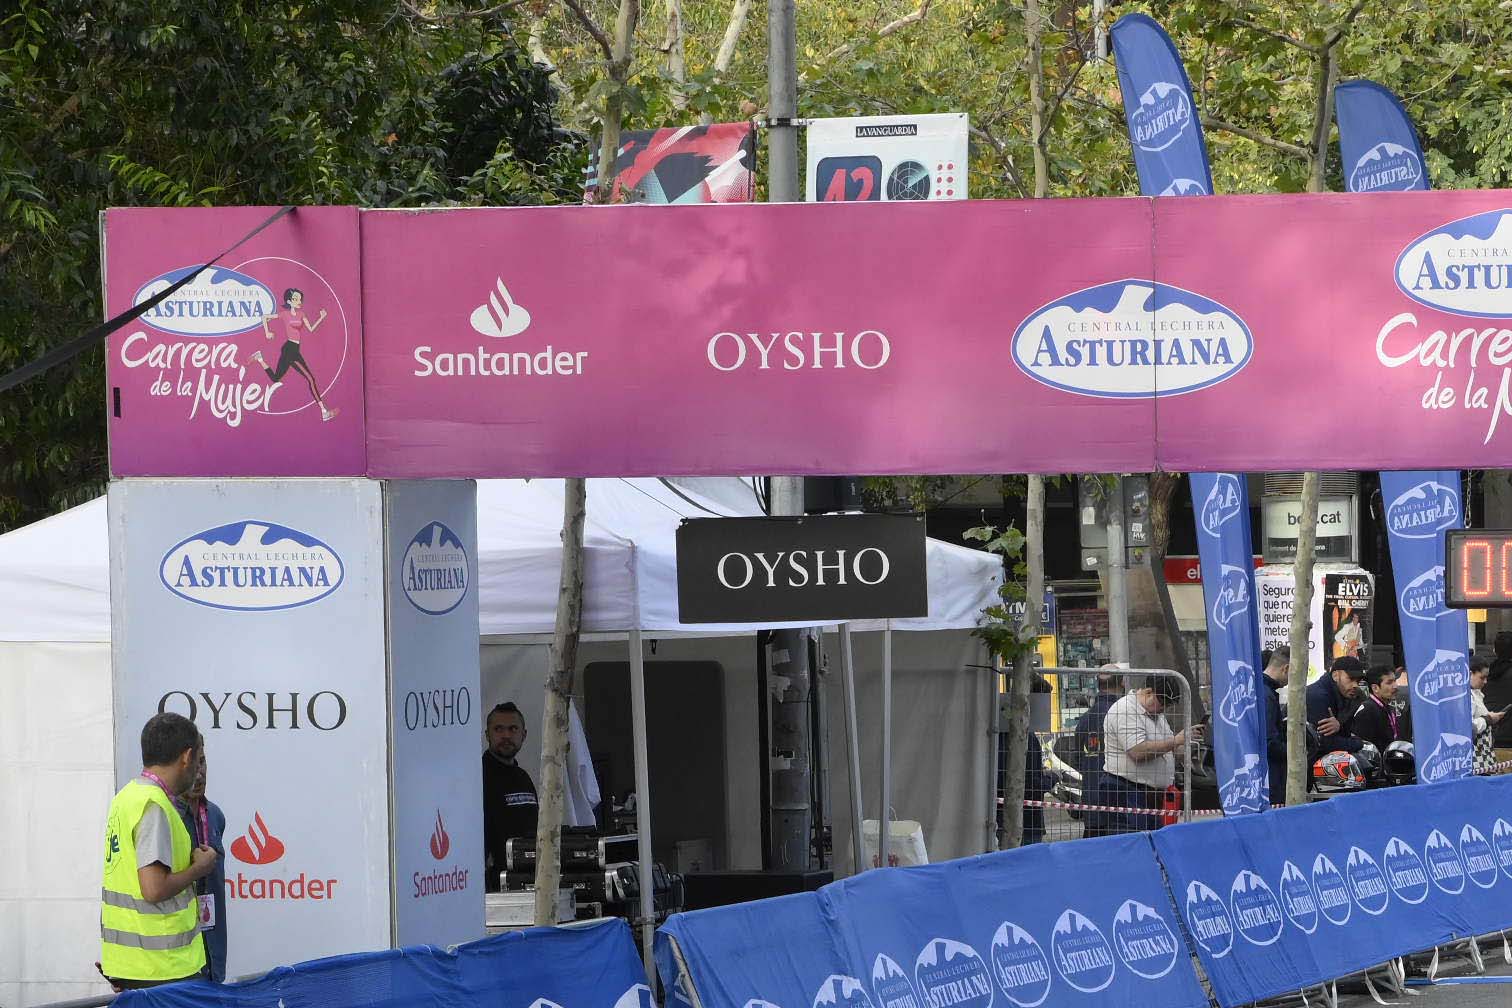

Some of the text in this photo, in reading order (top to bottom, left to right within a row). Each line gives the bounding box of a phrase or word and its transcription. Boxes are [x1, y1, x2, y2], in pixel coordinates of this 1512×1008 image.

[867, 125, 916, 136] VANGUARDIA
[1067, 319, 1226, 333] CENTRAL LECHERA
[120, 331, 239, 369] Carrera
[414, 345, 588, 377] Santander
[707, 329, 891, 372] OYSHO
[1031, 324, 1235, 368] ASTURIANA
[150, 365, 284, 428] de la Mujer
[1421, 371, 1456, 410] de
[1463, 368, 1488, 410] la
[174, 554, 331, 590] ASTURIANA
[202, 550, 325, 562] CENTRAL LECHERA
[407, 555, 465, 591] ASTURIANA
[717, 547, 890, 590] OYSHO
[1264, 601, 1280, 610] que
[1338, 583, 1369, 596] ELVIS
[157, 690, 348, 731] OYSHO
[405, 685, 471, 731] OYSHO
[225, 872, 338, 900] ntander
[413, 868, 469, 899] Santander
